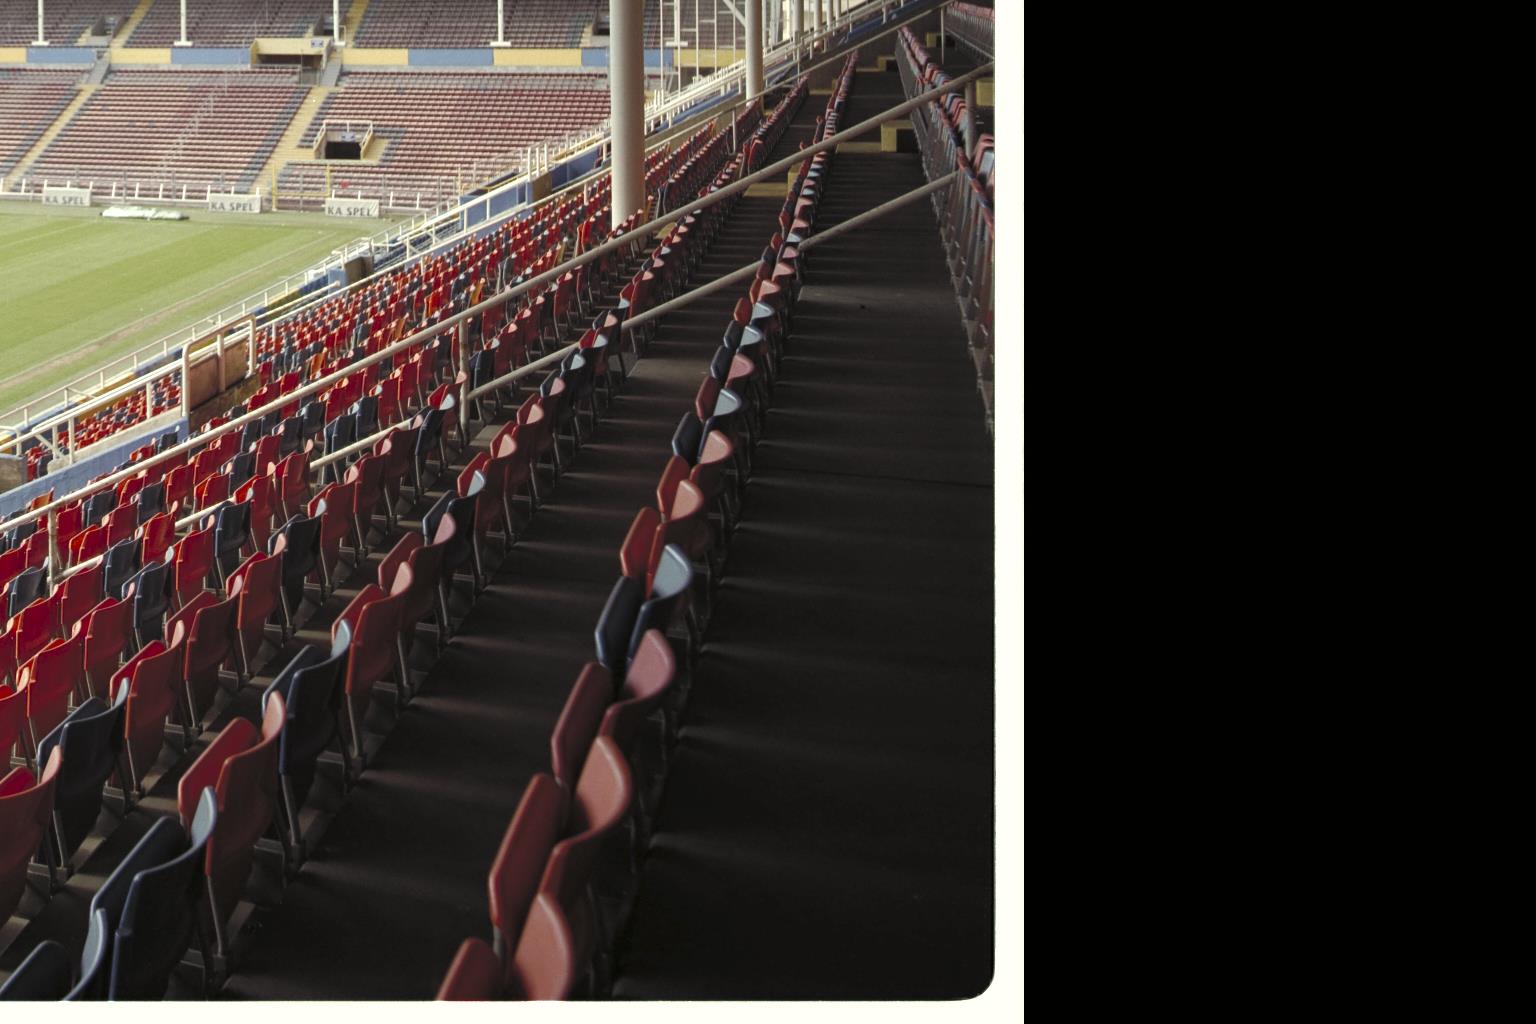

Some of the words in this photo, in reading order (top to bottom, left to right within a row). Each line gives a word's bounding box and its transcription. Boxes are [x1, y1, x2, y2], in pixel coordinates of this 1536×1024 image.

[210, 201, 226, 212] KA
[229, 201, 255, 212] SPEL
[327, 205, 343, 216] KA
[346, 206, 373, 217] SPEL
